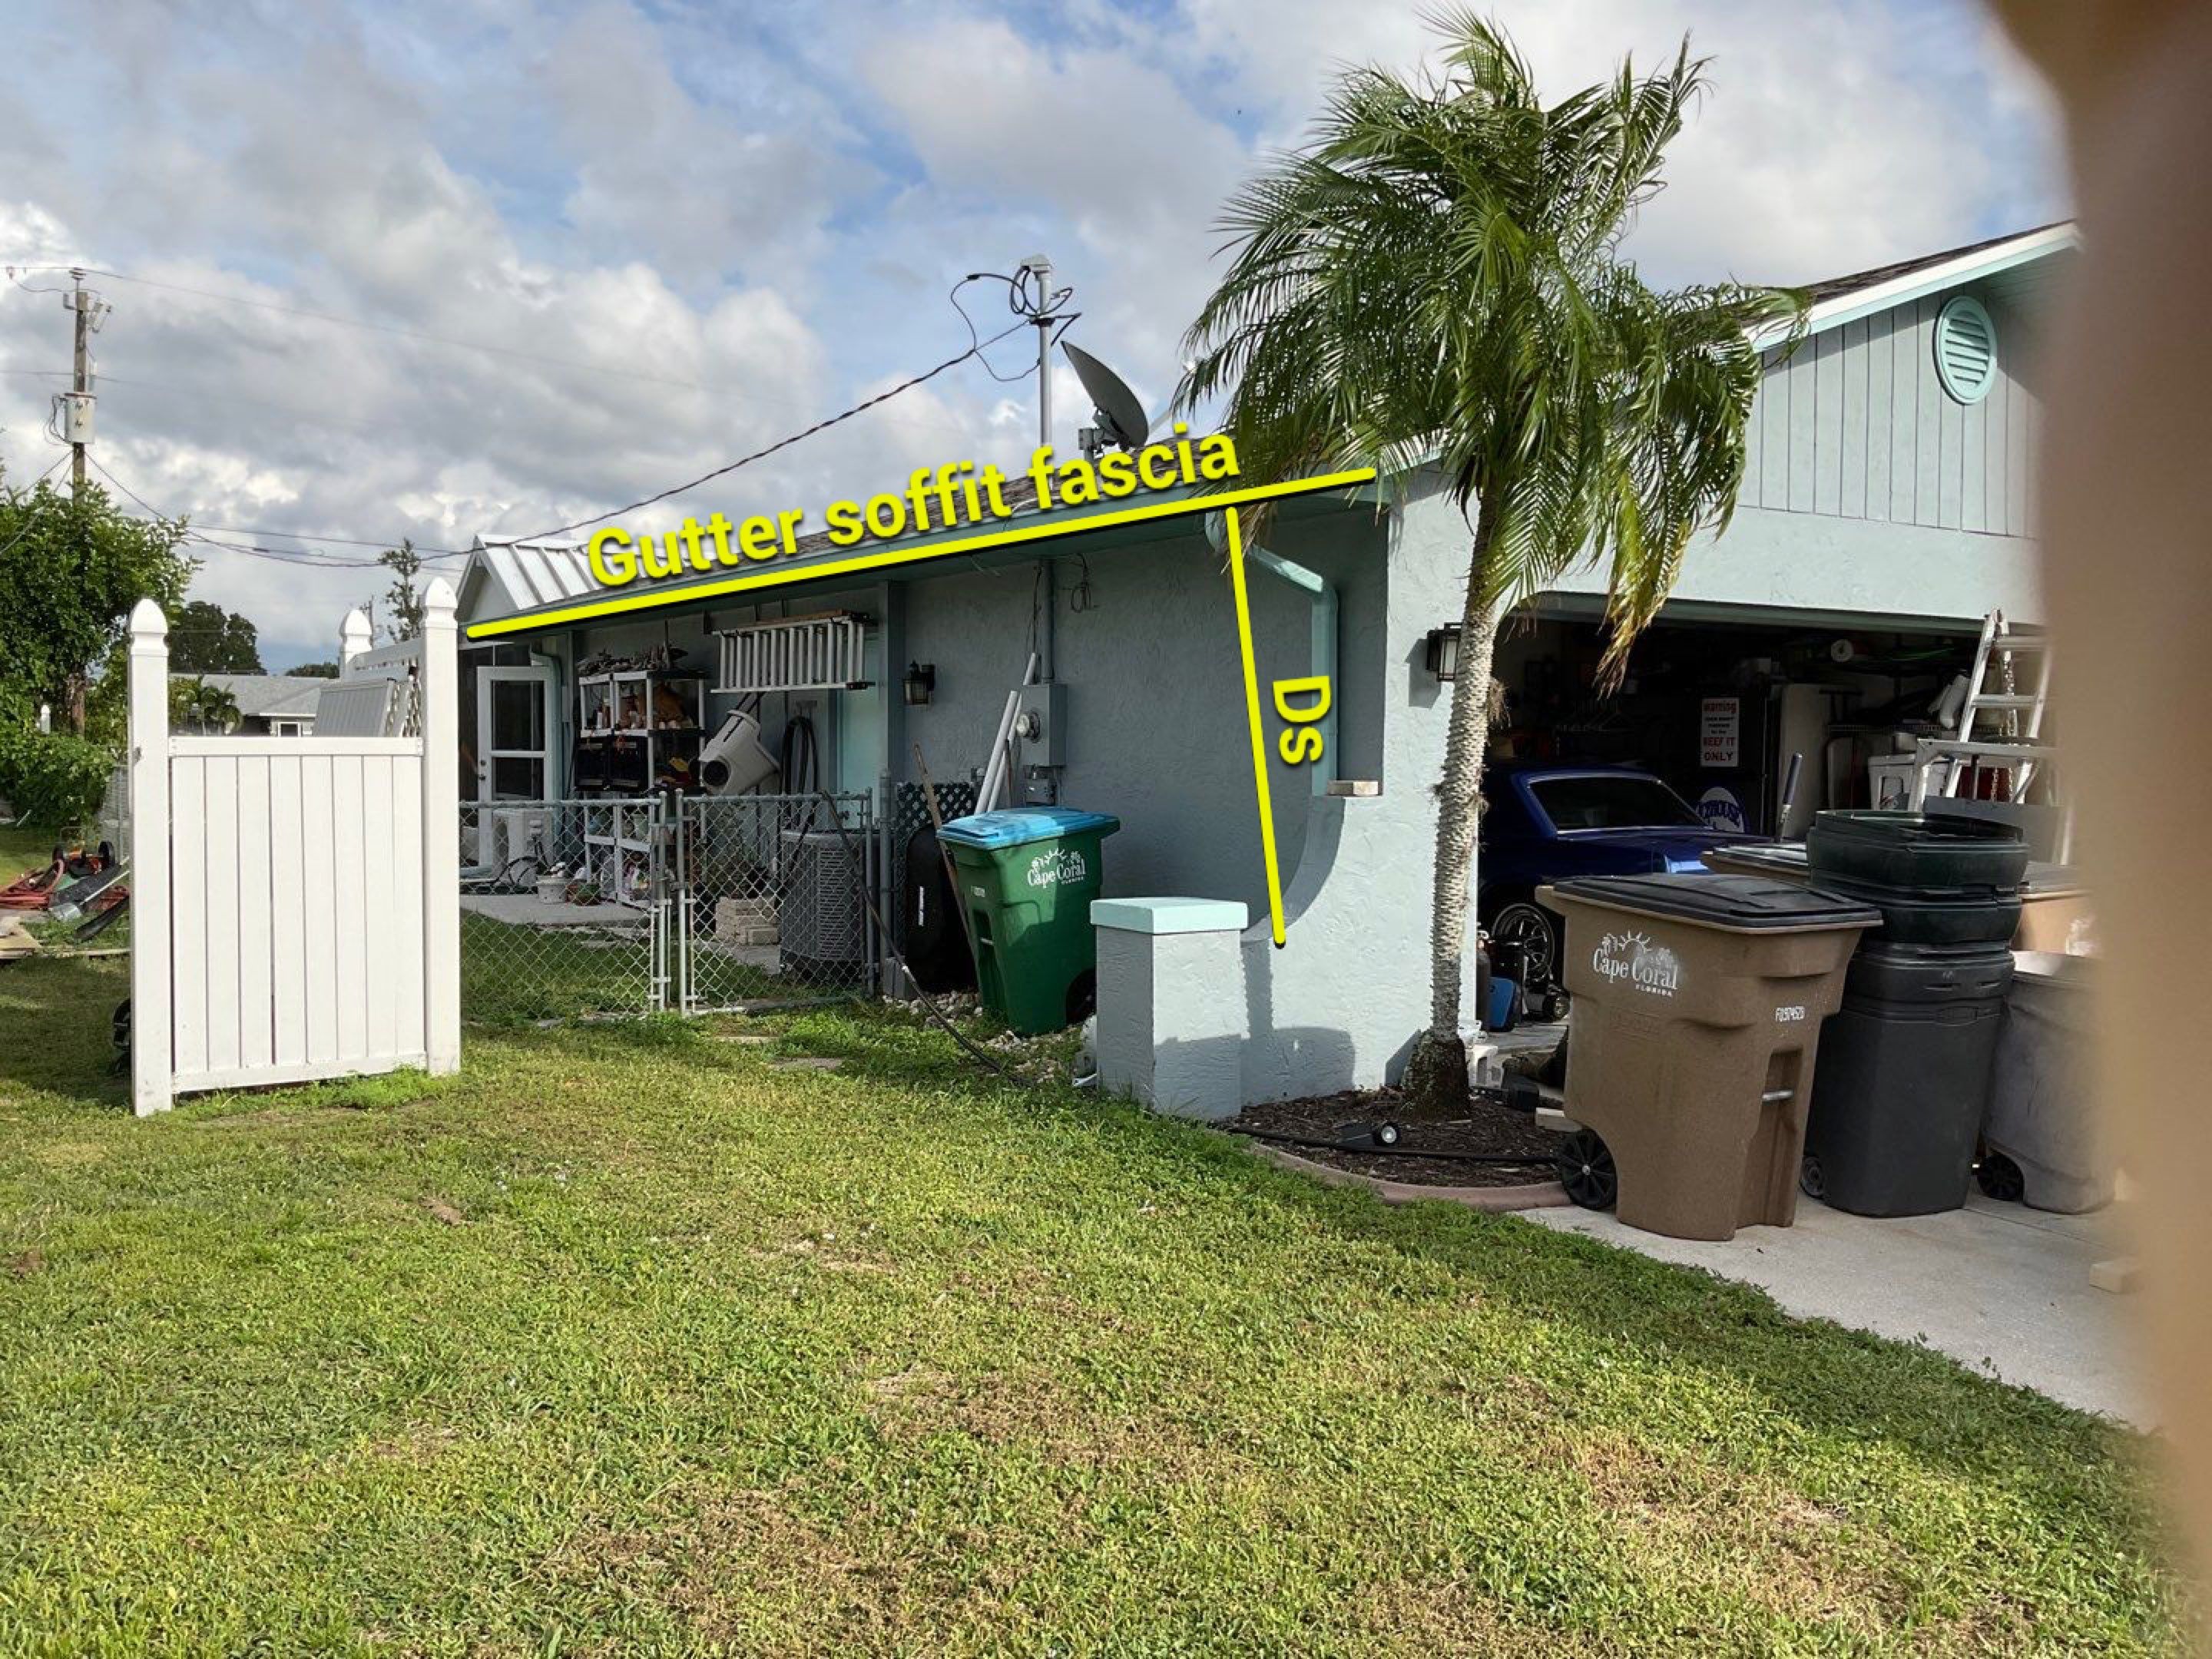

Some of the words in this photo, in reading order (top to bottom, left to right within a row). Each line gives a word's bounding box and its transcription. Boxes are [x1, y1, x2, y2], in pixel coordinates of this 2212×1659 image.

[1704, 750, 1734, 761] ONLY
[1027, 869, 1056, 889] Cape
[1056, 858, 1085, 879] Coral
[1594, 949, 1629, 984] Cape
[1632, 956, 1678, 990] Coral
